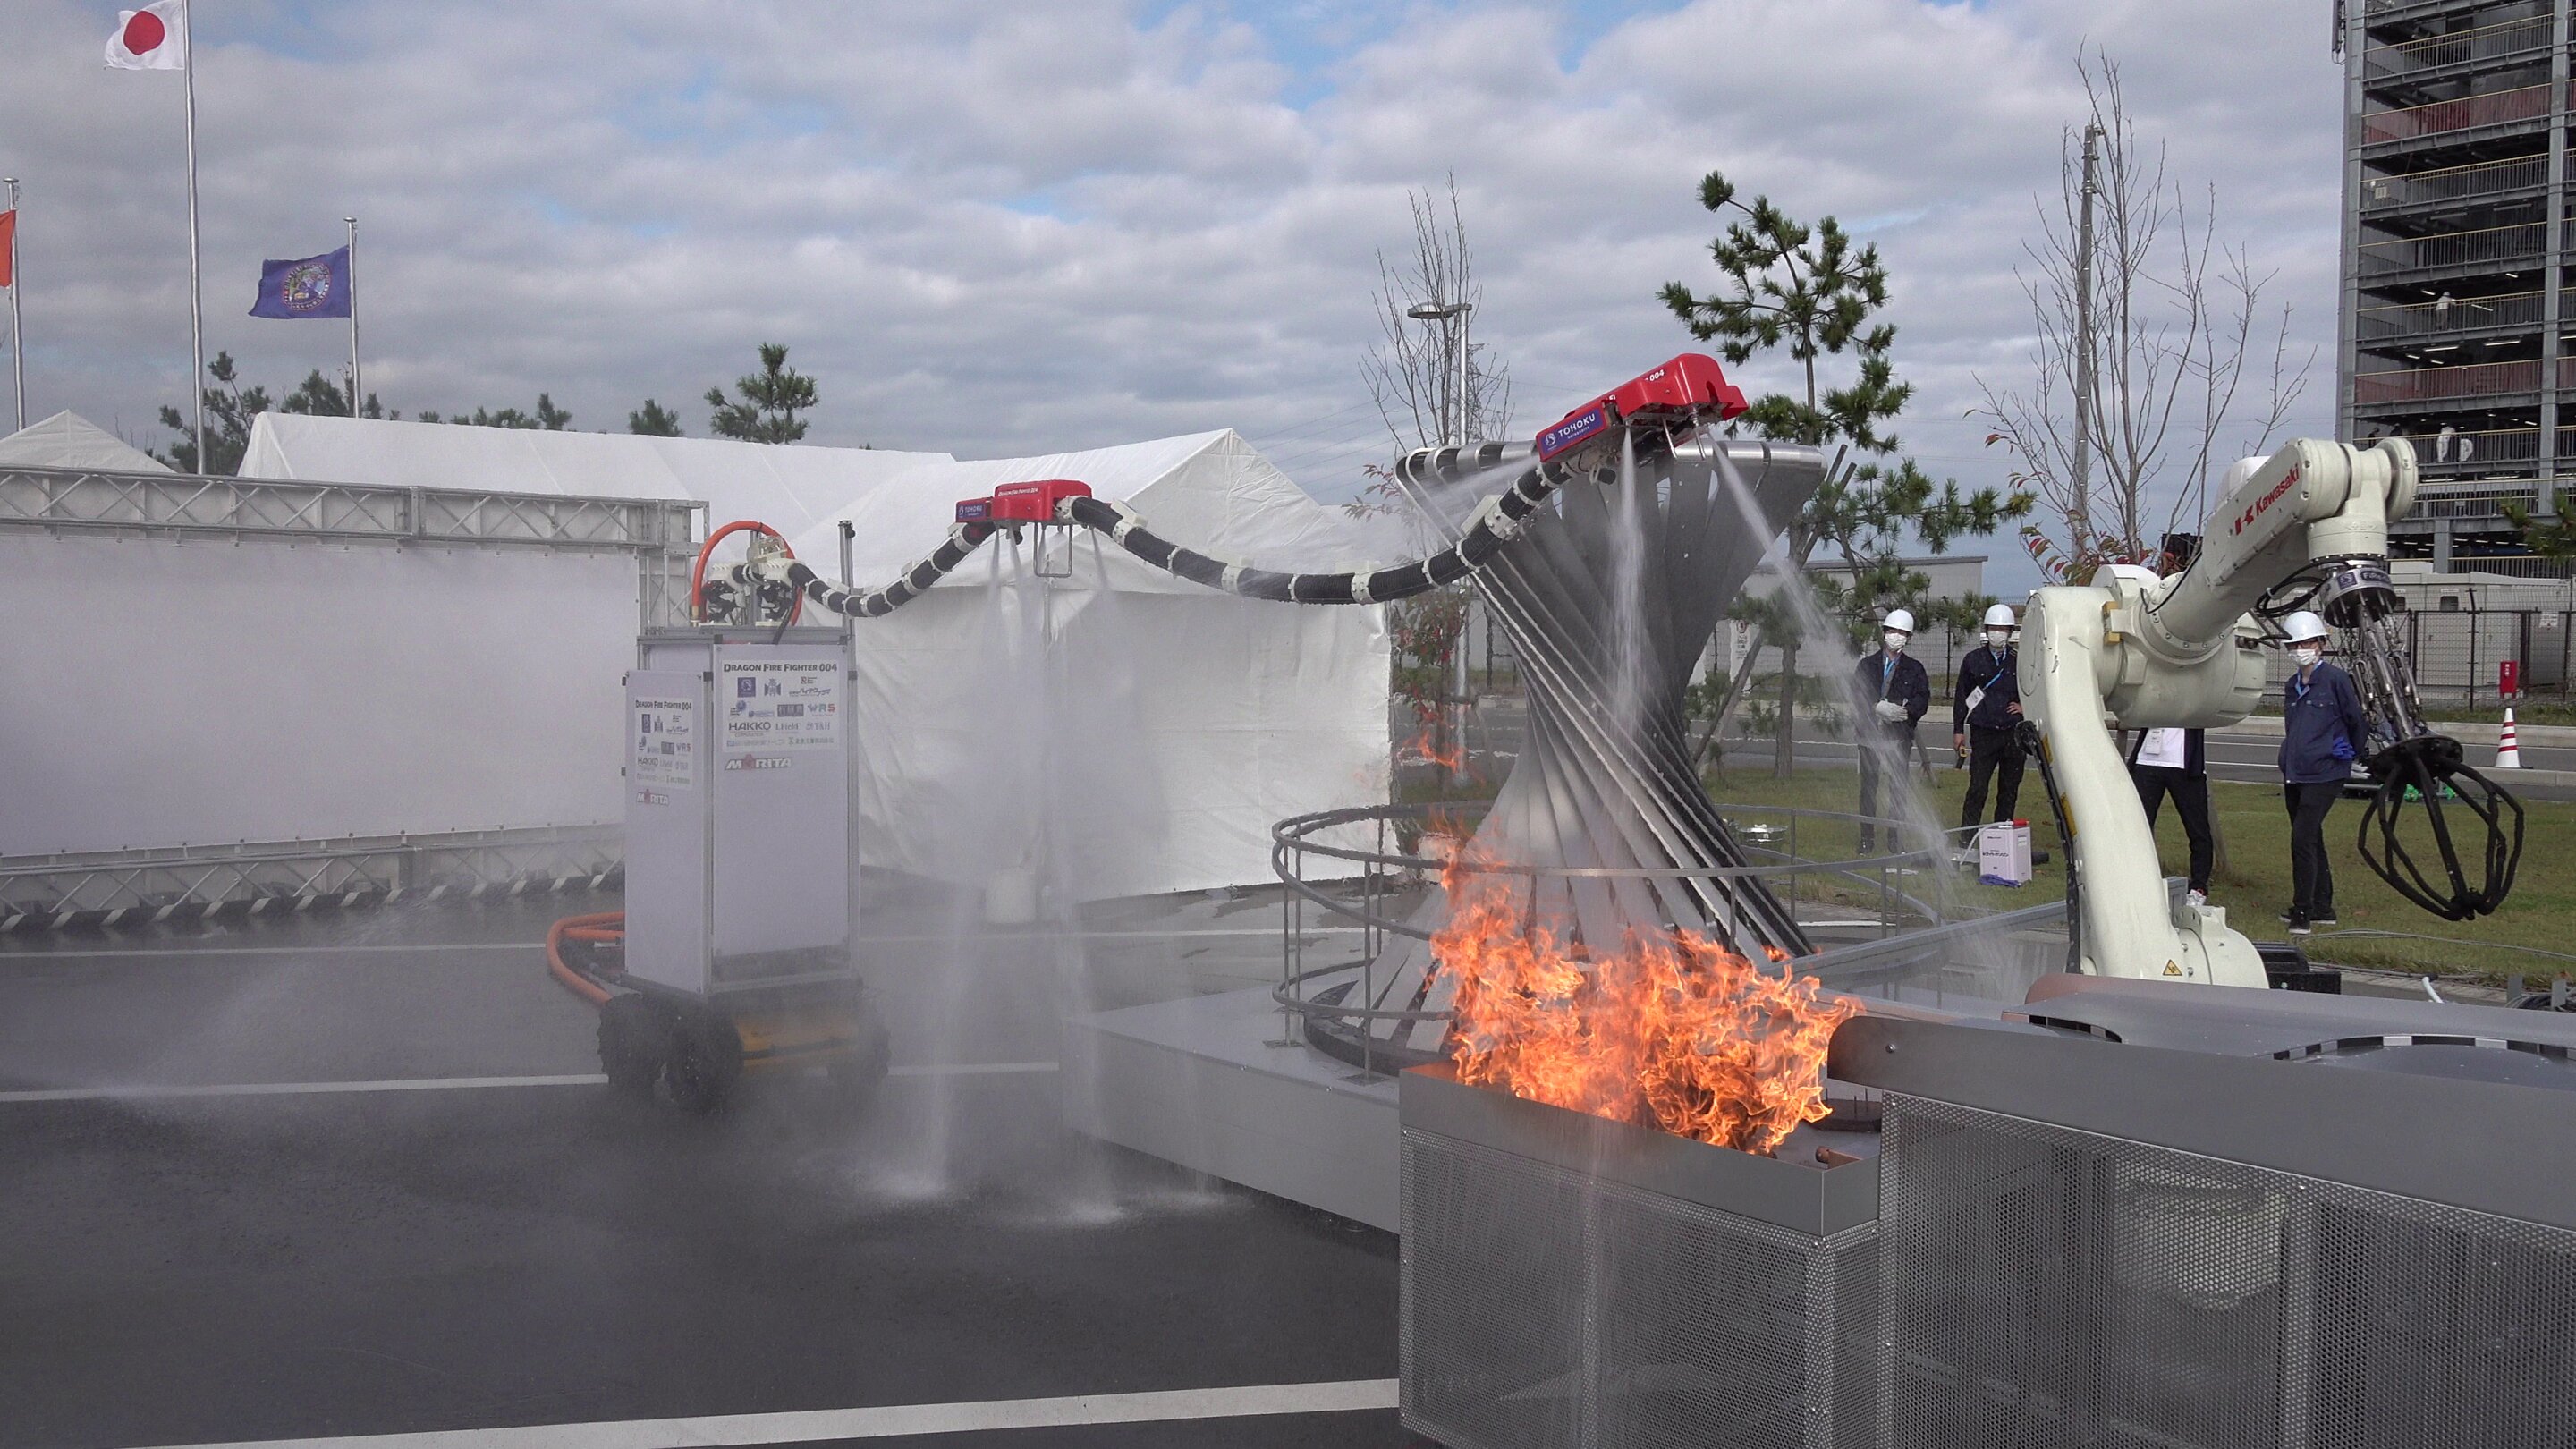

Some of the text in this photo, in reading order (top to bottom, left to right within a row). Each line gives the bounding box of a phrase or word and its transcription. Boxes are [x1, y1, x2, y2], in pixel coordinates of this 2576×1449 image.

[1649, 369, 1665, 382] 004
[1558, 413, 1596, 437] TOHOKU
[2256, 462, 2300, 516] Kawasaki
[724, 664, 837, 672] DRAGON FIRE FIGHTER 004
[682, 702, 691, 710] 004
[808, 703, 835, 712] WRS
[728, 721, 771, 730] HAKKO
